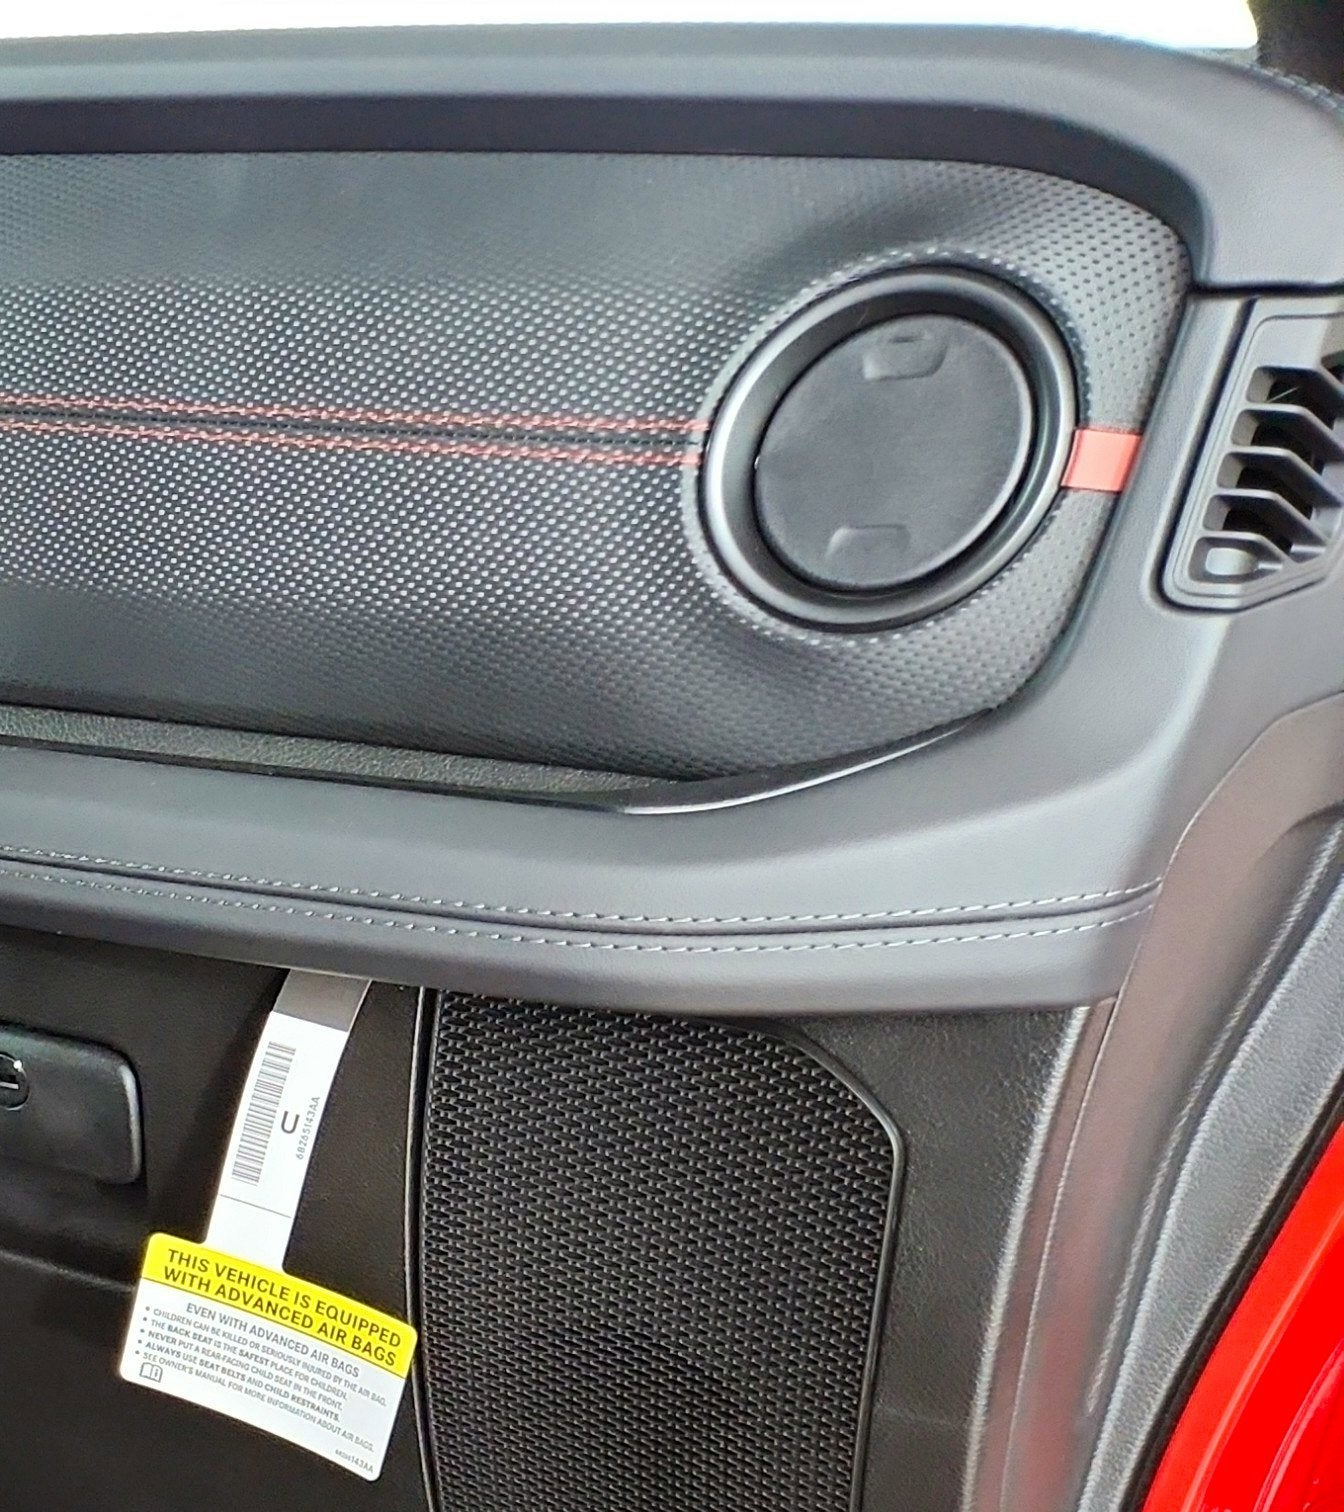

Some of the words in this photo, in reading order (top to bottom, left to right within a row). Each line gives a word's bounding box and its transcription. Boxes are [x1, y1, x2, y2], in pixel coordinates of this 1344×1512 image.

[281, 1110, 300, 1134] U
[164, 1266, 211, 1293] WITH
[215, 1284, 313, 1329] ADVANCED
[317, 1322, 347, 1345] AIR
[351, 1335, 396, 1367] BAGS
[168, 1248, 210, 1273] THIS
[215, 1262, 291, 1301] VEHICLE
[294, 1291, 311, 1309] IS
[315, 1300, 401, 1347] EQUIPPED
[145, 1341, 181, 1358] ALWAYS
[182, 1353, 198, 1364] USE
[198, 1358, 220, 1372] SEAT
[221, 1365, 246, 1381] BELTS
[246, 1375, 264, 1388] AND
[264, 1383, 290, 1399] CHILD
[148, 1330, 177, 1346] NEVER
[178, 1339, 194, 1351] PUT
[194, 1345, 200, 1353] A
[201, 1347, 250, 1371] REAR-FACING
[251, 1366, 273, 1381] CHILD
[274, 1375, 293, 1388] SEAT
[293, 1382, 303, 1391] IN
[303, 1386, 317, 1398] THE
[151, 1319, 165, 1331] THE
[167, 1323, 191, 1338] BACK
[192, 1332, 213, 1346] SEAT
[213, 1338, 222, 1348] IS
[222, 1340, 238, 1355] THE
[238, 1349, 270, 1367] SAFEST
[271, 1360, 294, 1377] PLACE
[294, 1371, 310, 1383] FOR
[153, 1308, 192, 1327] CHILDREN
[193, 1321, 209, 1333] CAN
[211, 1326, 221, 1336] BE
[221, 1329, 248, 1347] KILLED
[248, 1340, 261, 1351] OR
[261, 1346, 301, 1366] SERIOUSLY
[302, 1361, 332, 1380] INJURED
[333, 1374, 344, 1385] BY
[344, 1378, 357, 1393] THE
[358, 1386, 370, 1399] AIR
[186, 1302, 217, 1321] EVEN
[219, 1312, 248, 1332] WITH
[249, 1325, 309, 1356] ADVANCED
[310, 1349, 330, 1365] AIR
[332, 1357, 360, 1378] BAGS
[142, 1352, 158, 1363] SEE
[158, 1357, 194, 1375] OWNER'S
[195, 1368, 227, 1387] MANUAL
[228, 1381, 244, 1393] FOR
[244, 1388, 266, 1402] MORE
[267, 1396, 317, 1424] INFORMATION
[317, 1418, 342, 1435] ABOUT
[342, 1430, 354, 1442] AIR
